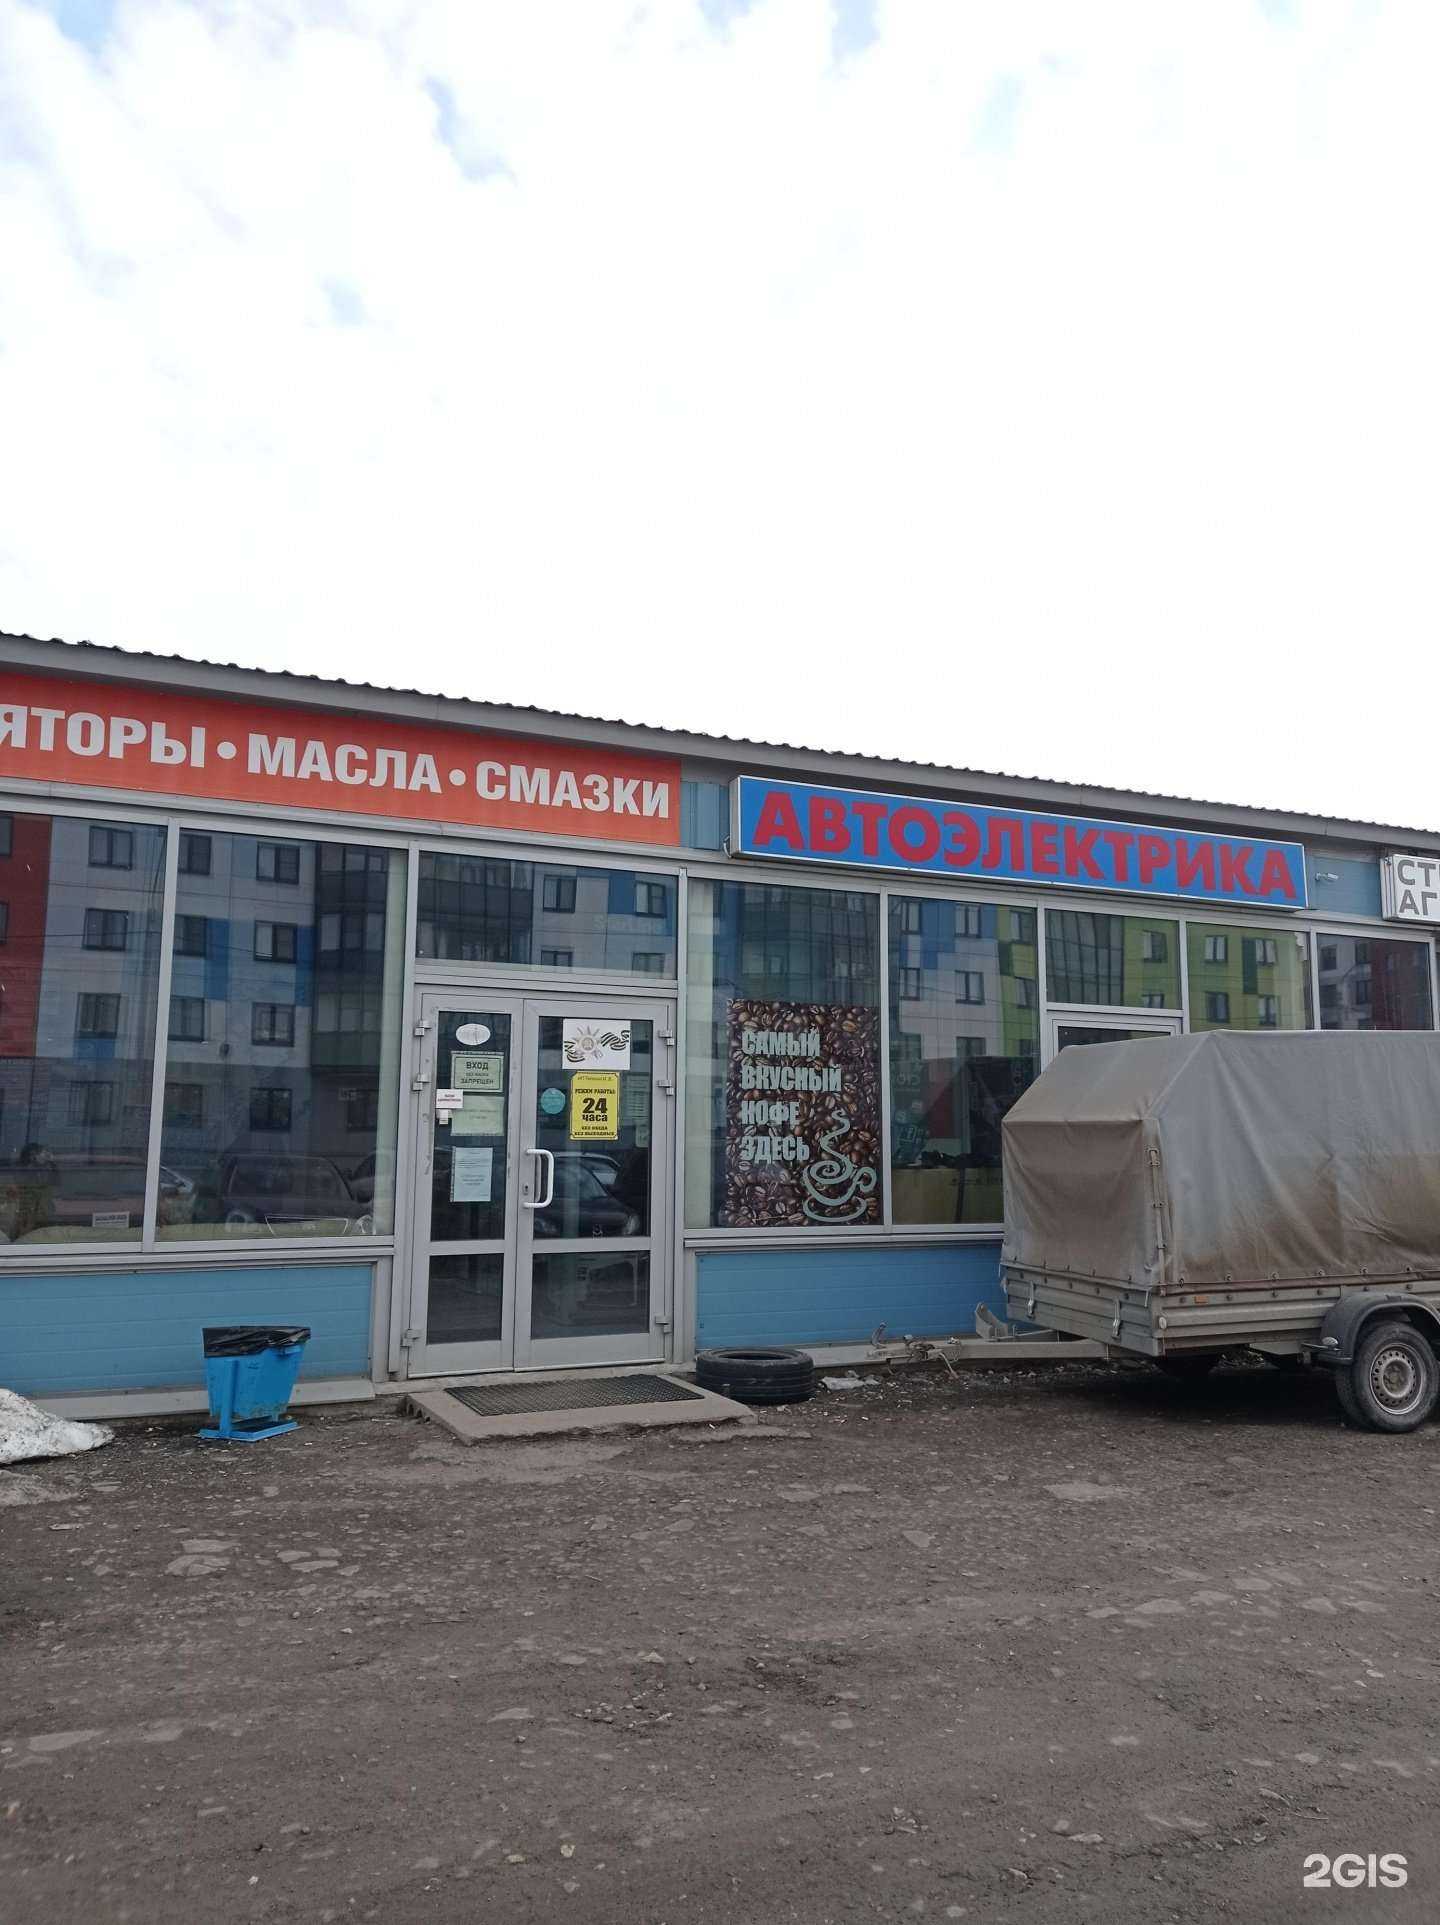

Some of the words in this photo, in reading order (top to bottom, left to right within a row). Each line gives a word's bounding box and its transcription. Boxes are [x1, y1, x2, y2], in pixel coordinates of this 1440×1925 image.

[0, 703, 205, 768] ЯТОРЫ
[247, 733, 442, 794] МАСЛА
[476, 761, 669, 818] СМАЗКИ
[752, 791, 1296, 899] АВТОЭЛЕКТРИКА
[1397, 859, 1440, 888] СТ
[1399, 889, 1438, 916] АГ
[741, 1028, 821, 1057] САМЫЙ
[466, 1061, 489, 1071] ВХОД
[741, 1064, 842, 1092] ВКУСНЫЙ
[582, 1097, 608, 1114] 24
[582, 1114, 608, 1122] часа
[741, 1099, 801, 1128] КОФЕ
[740, 1136, 811, 1165] ЗДЕСЬ
